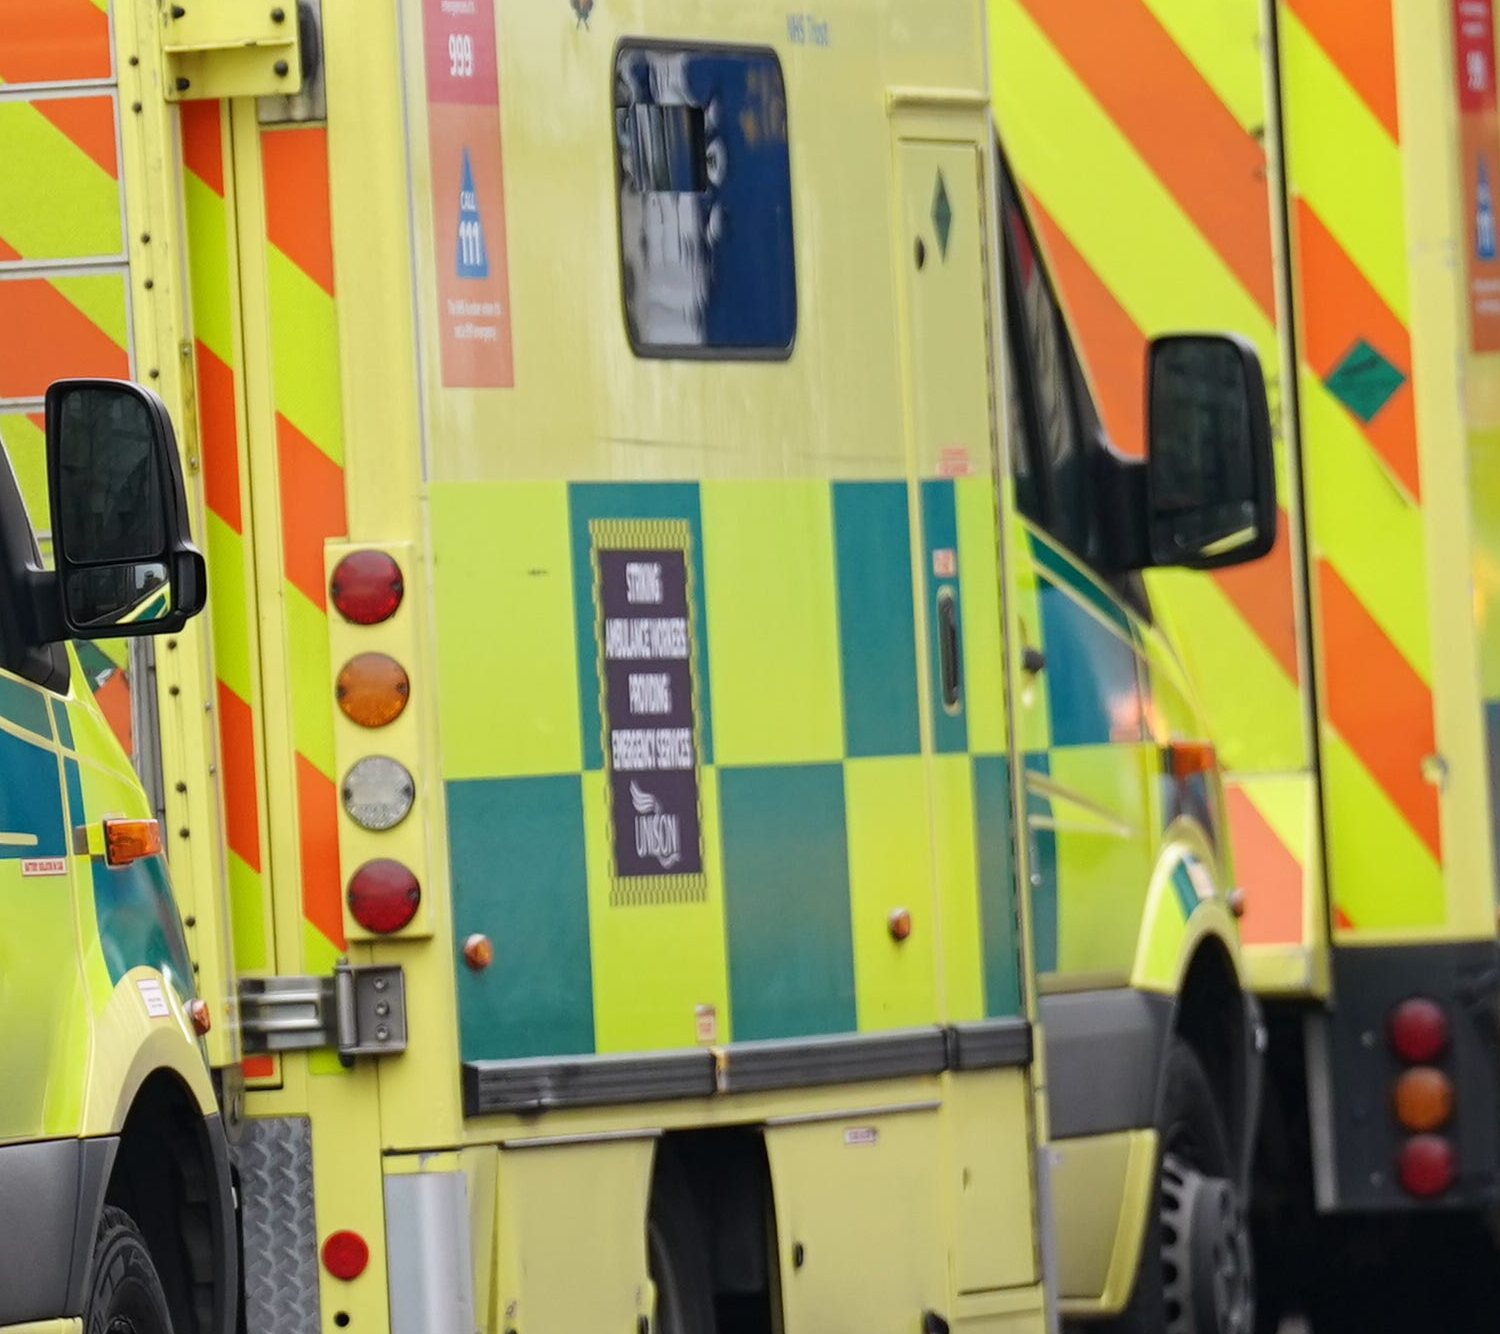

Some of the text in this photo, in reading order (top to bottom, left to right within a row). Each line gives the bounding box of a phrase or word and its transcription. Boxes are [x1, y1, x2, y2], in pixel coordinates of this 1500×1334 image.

[448, 33, 473, 77] 999
[459, 220, 480, 266] 111
[626, 561, 664, 605] STRIKING
[605, 616, 690, 659] AMBULANCE WORKERS
[611, 727, 694, 771] EMERGENCY SERVICES
[634, 813, 680, 859] UNISON
